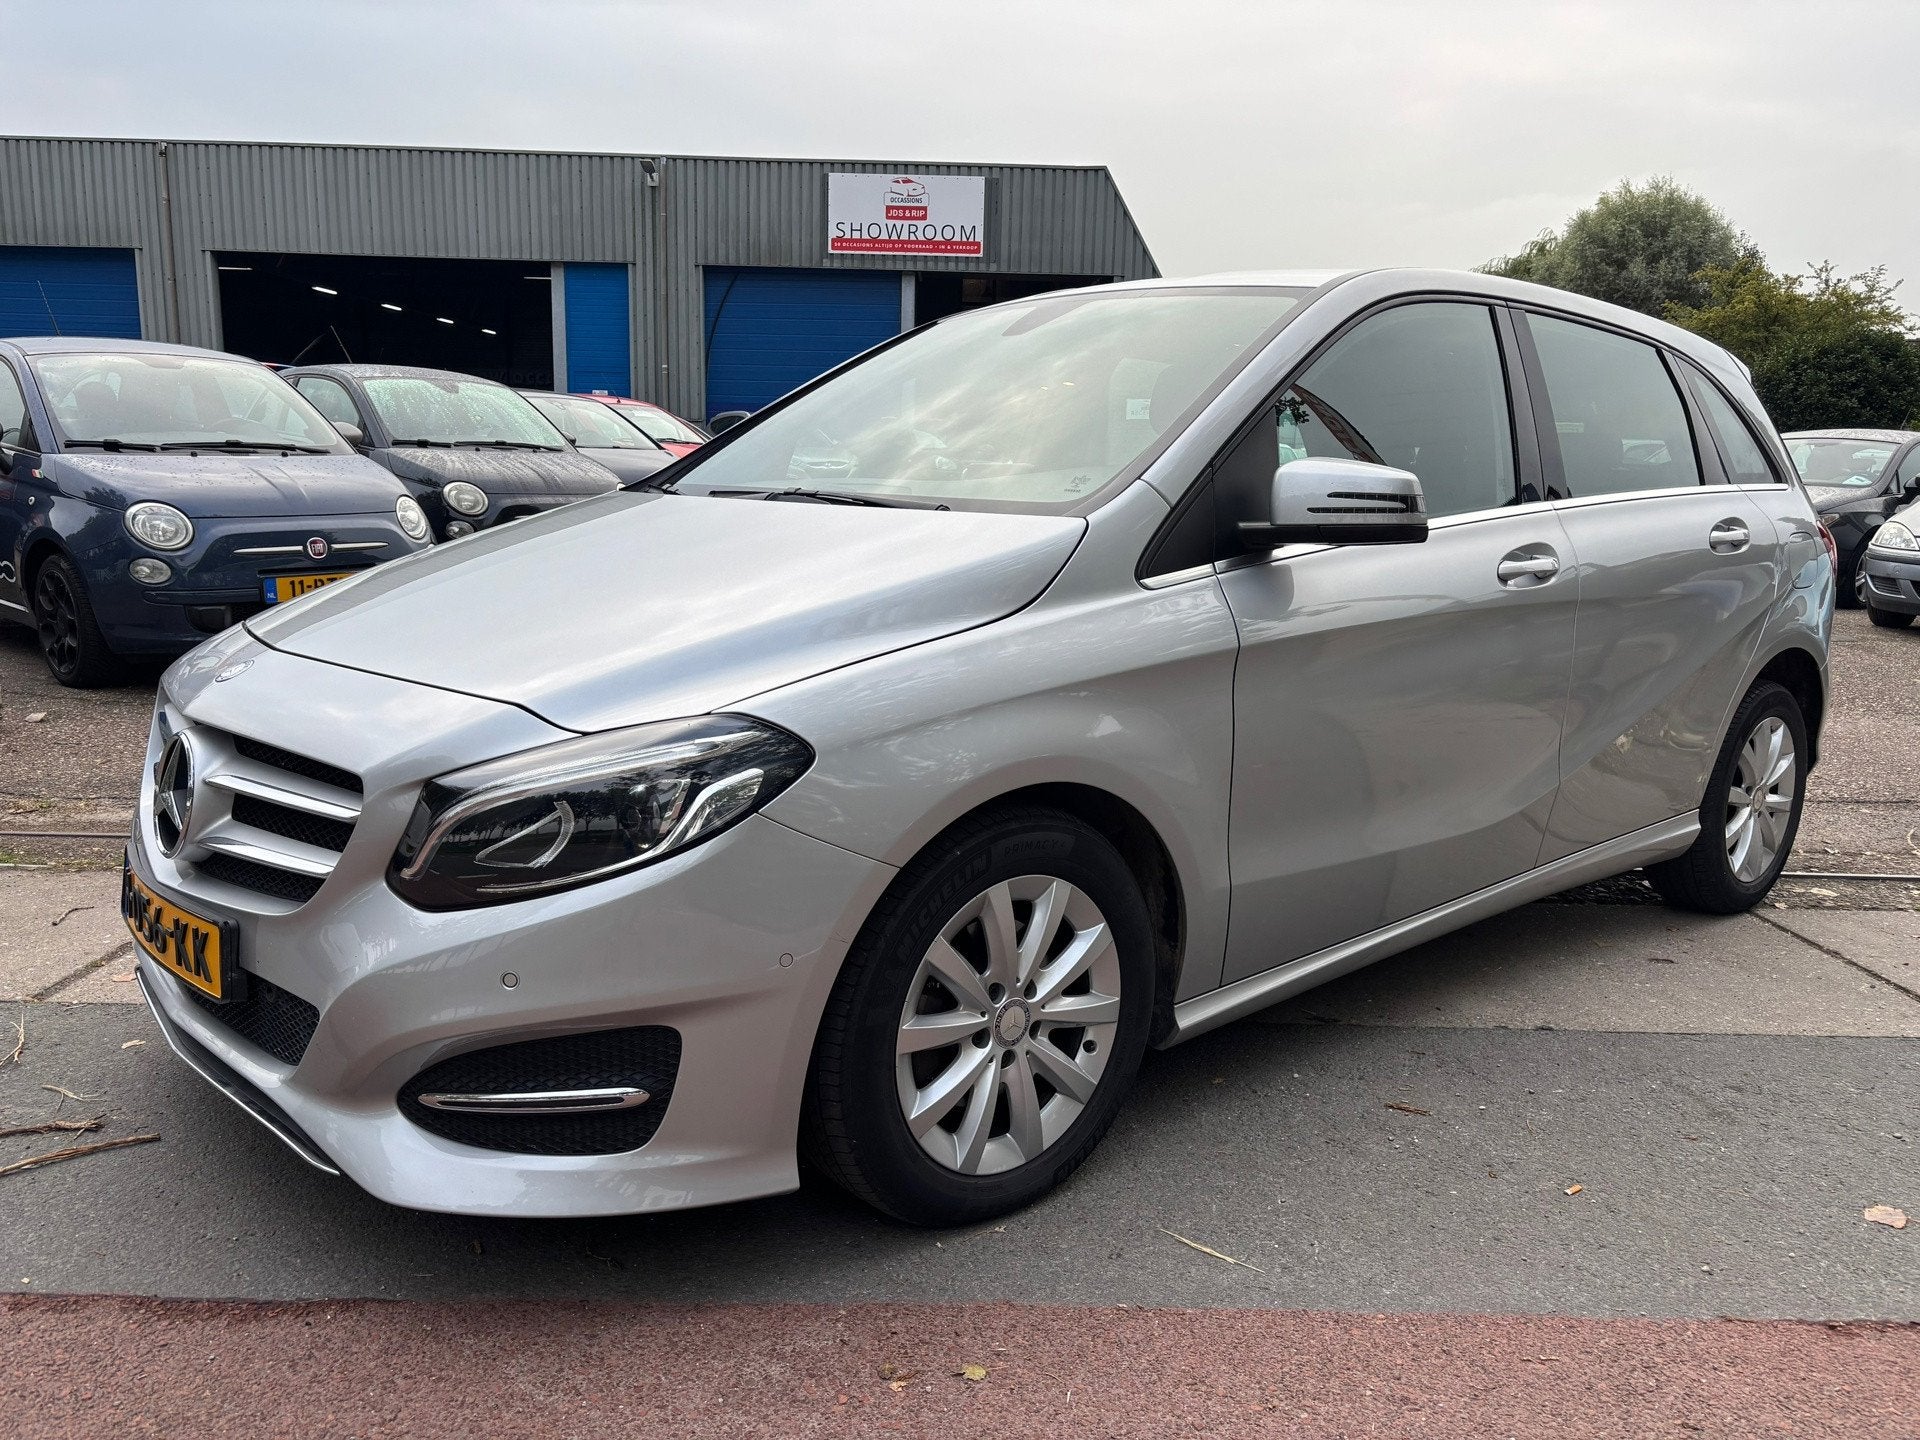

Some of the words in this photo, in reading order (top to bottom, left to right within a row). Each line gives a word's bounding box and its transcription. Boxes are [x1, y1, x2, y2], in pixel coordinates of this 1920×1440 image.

[887, 209, 904, 217] JDS
[904, 209, 911, 217] &
[835, 221, 977, 242] SHOWROOM
[311, 543, 324, 553] FIAT
[897, 853, 987, 960] MICHELIN
